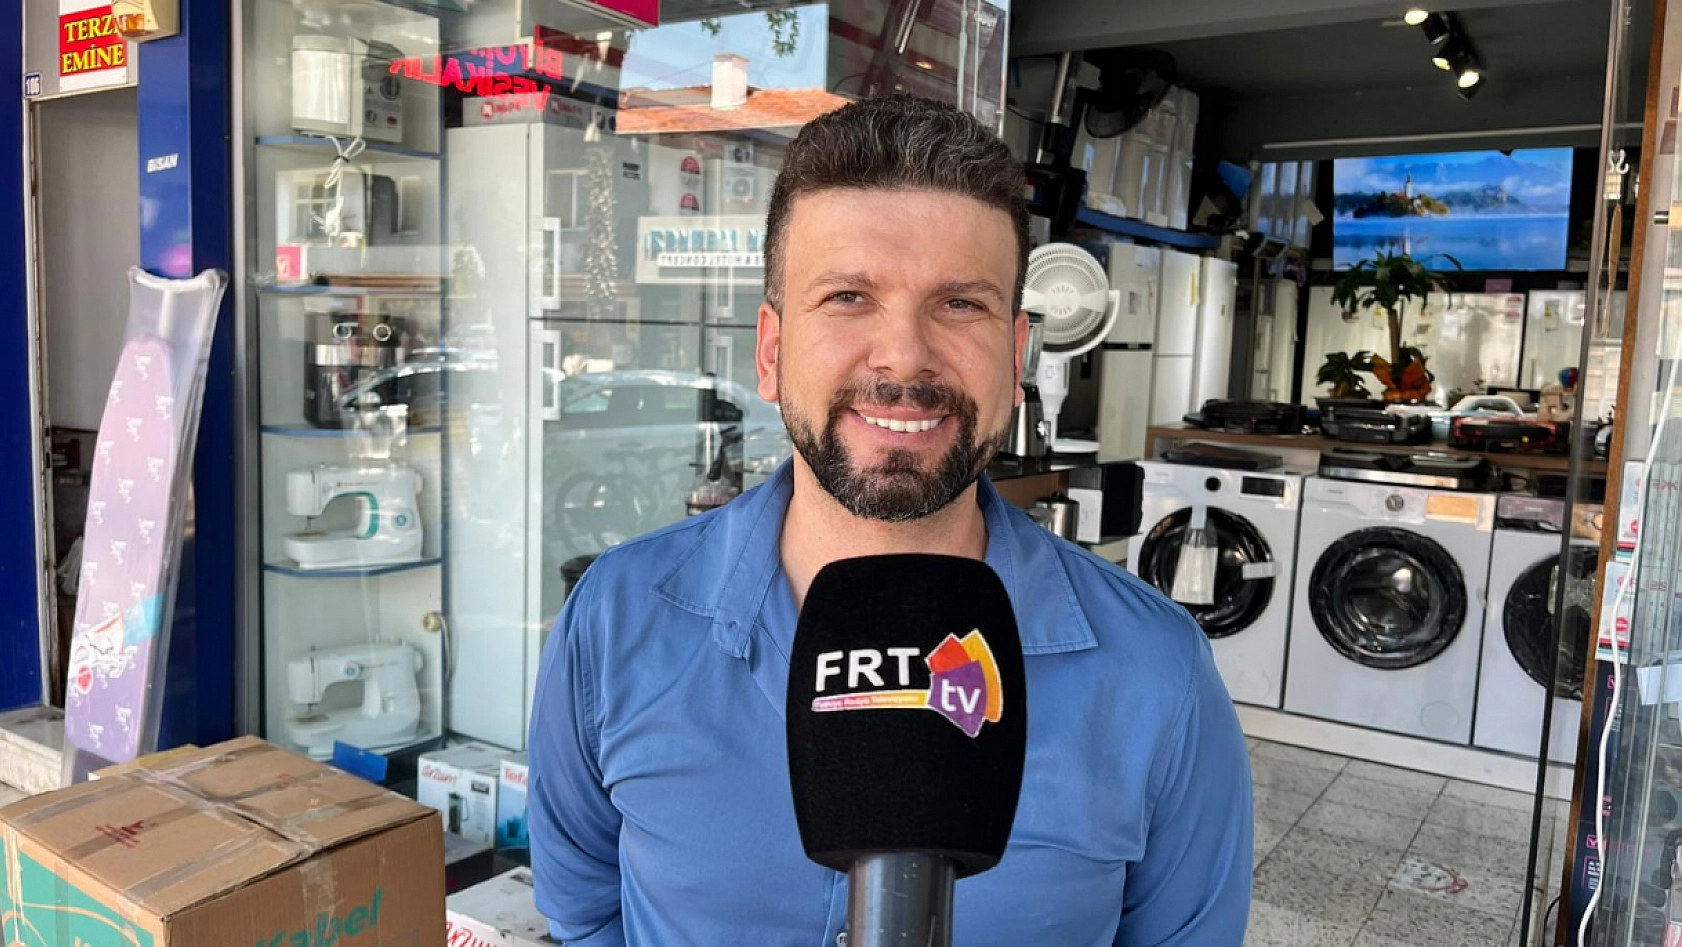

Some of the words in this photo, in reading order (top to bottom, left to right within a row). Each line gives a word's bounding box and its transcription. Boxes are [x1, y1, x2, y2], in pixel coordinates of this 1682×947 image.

[64, 14, 118, 43] TERZ
[62, 44, 124, 73] EMİNE
[815, 647, 920, 692] FRT
[941, 678, 981, 714] tv
